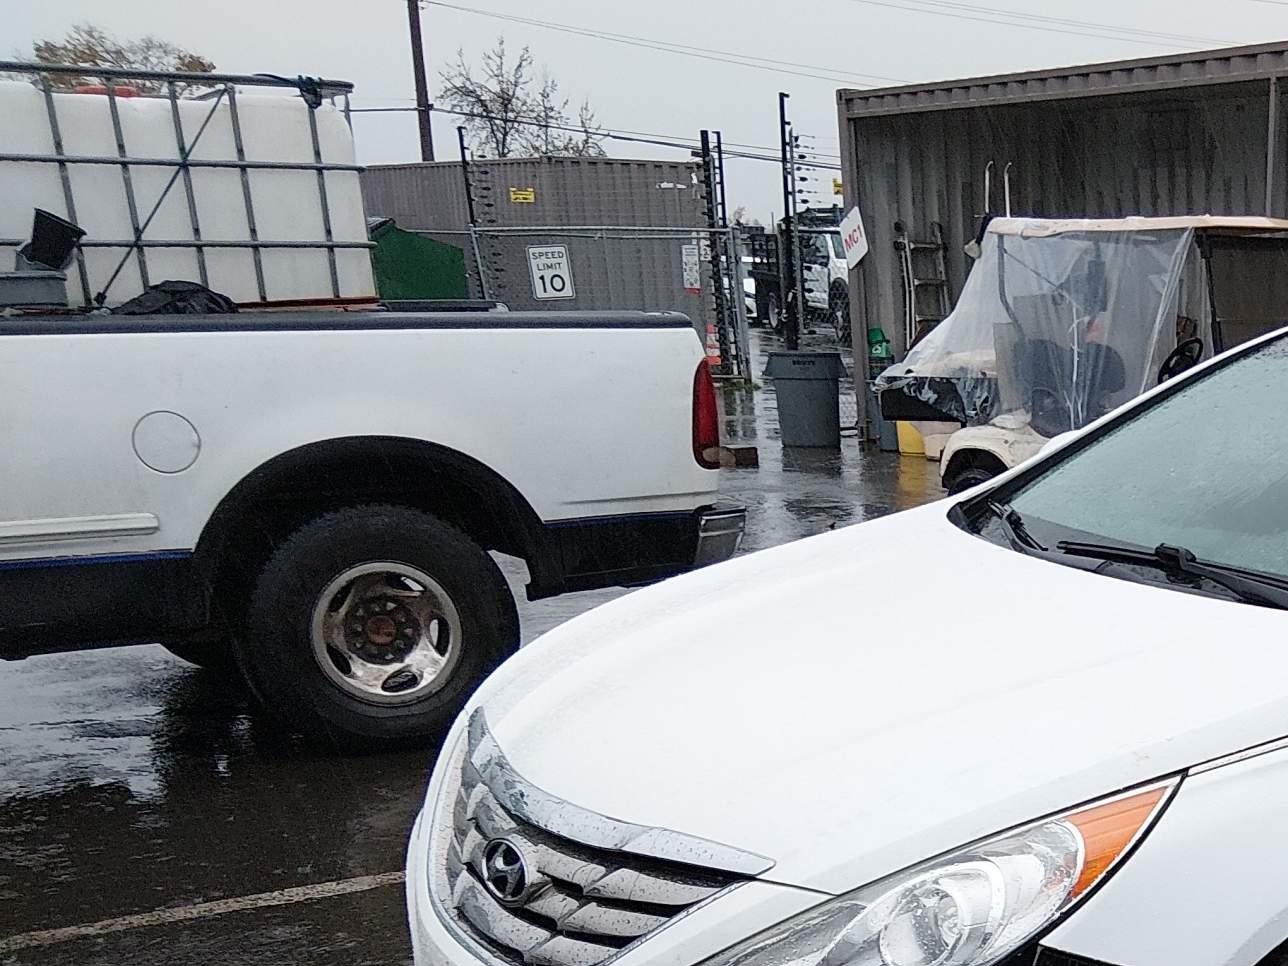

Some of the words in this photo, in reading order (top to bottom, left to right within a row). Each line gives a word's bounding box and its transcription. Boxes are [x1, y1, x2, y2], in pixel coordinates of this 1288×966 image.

[844, 224, 863, 252] MC1
[531, 251, 564, 260] SPEED
[536, 262, 562, 271] LIMIT
[538, 274, 566, 293] 10
